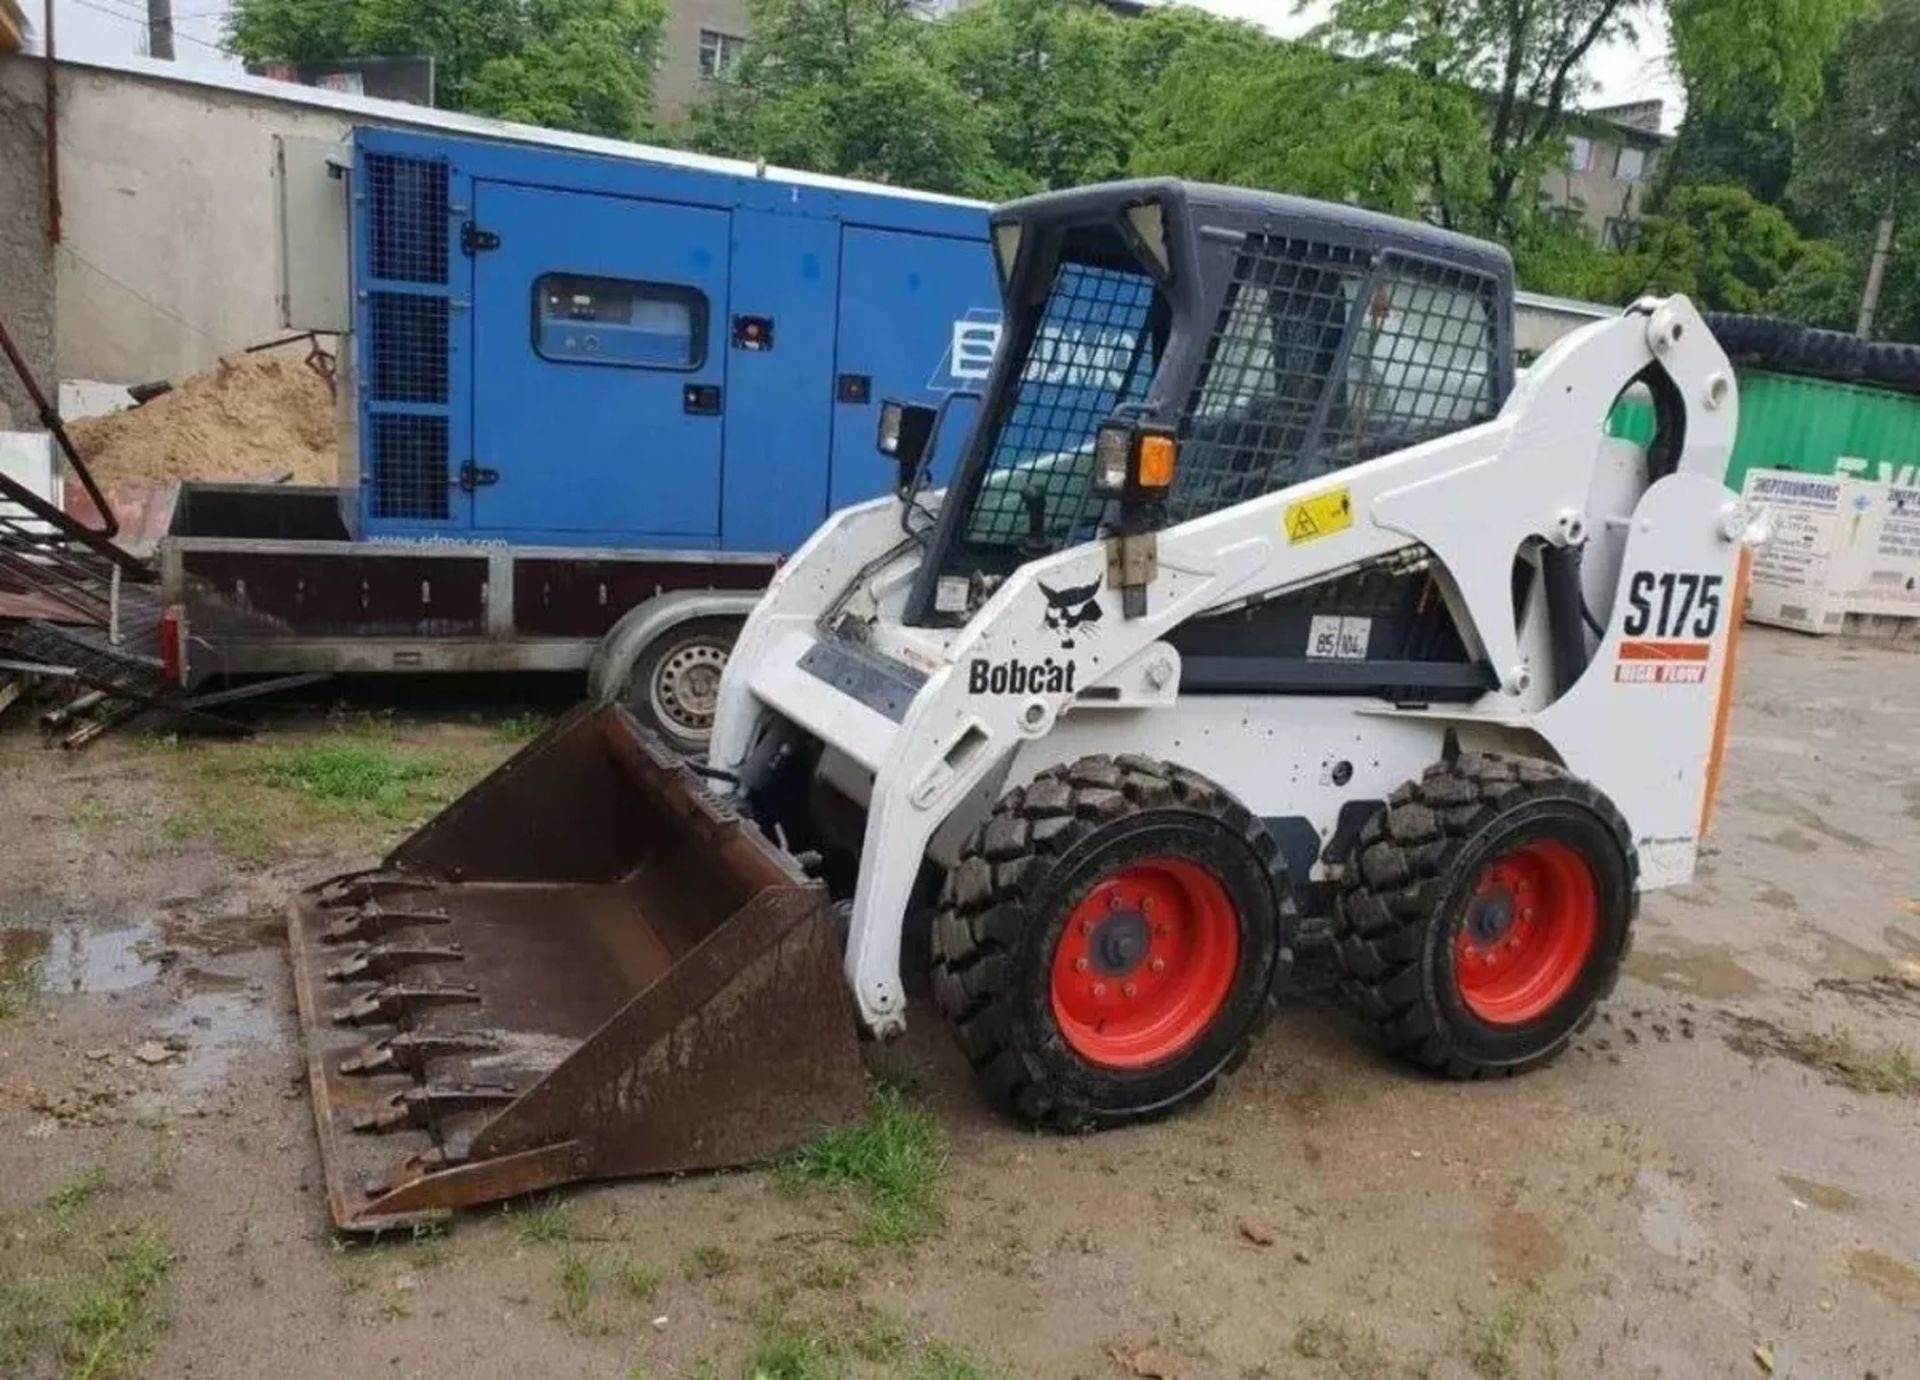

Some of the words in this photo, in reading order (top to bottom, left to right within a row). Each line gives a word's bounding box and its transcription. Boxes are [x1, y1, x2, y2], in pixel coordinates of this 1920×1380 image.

[1624, 571, 1723, 638] S175
[969, 658, 1076, 694] Bobcat
[1662, 665, 1701, 682] FLOW
